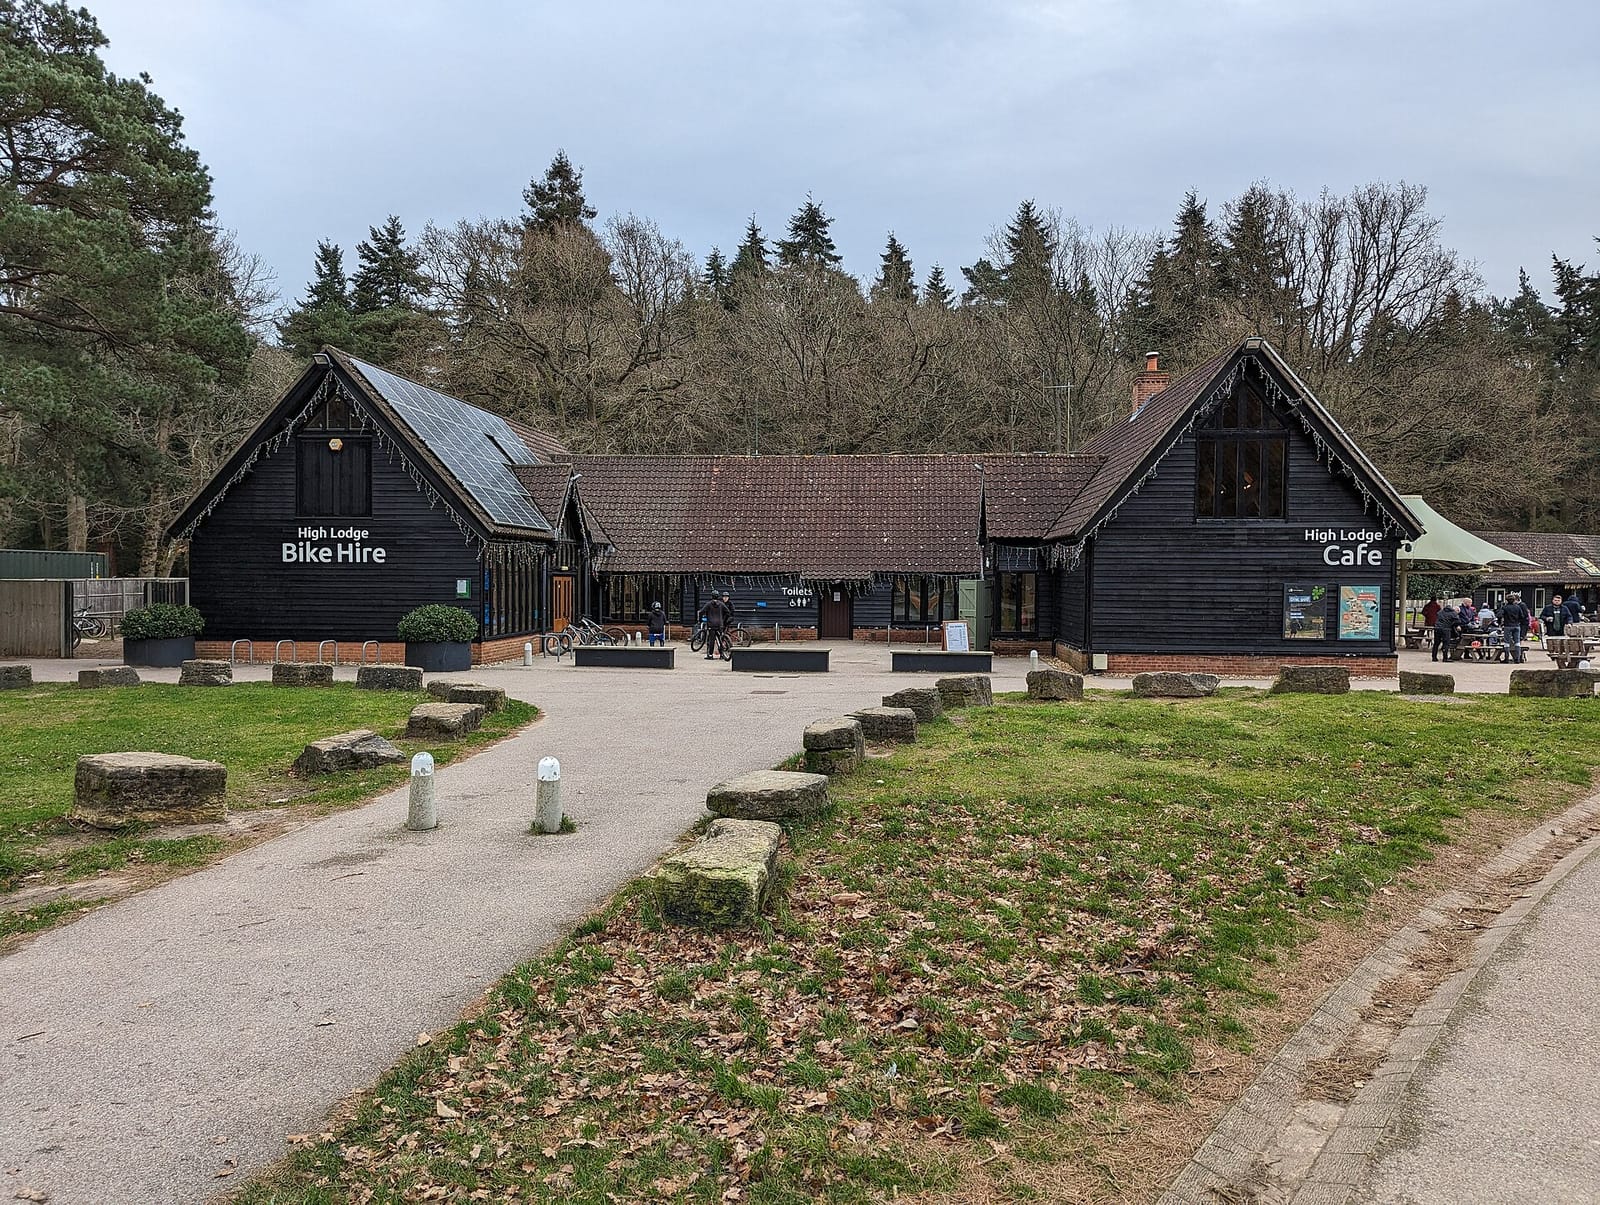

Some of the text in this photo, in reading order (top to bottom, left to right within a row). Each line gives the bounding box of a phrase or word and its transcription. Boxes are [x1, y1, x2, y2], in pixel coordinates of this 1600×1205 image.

[298, 526, 369, 541] High Lodge
[1305, 528, 1383, 543] High Lodge
[282, 541, 387, 563] Bike Hire
[1323, 543, 1383, 566] Cafe
[781, 584, 813, 596] Toilets
